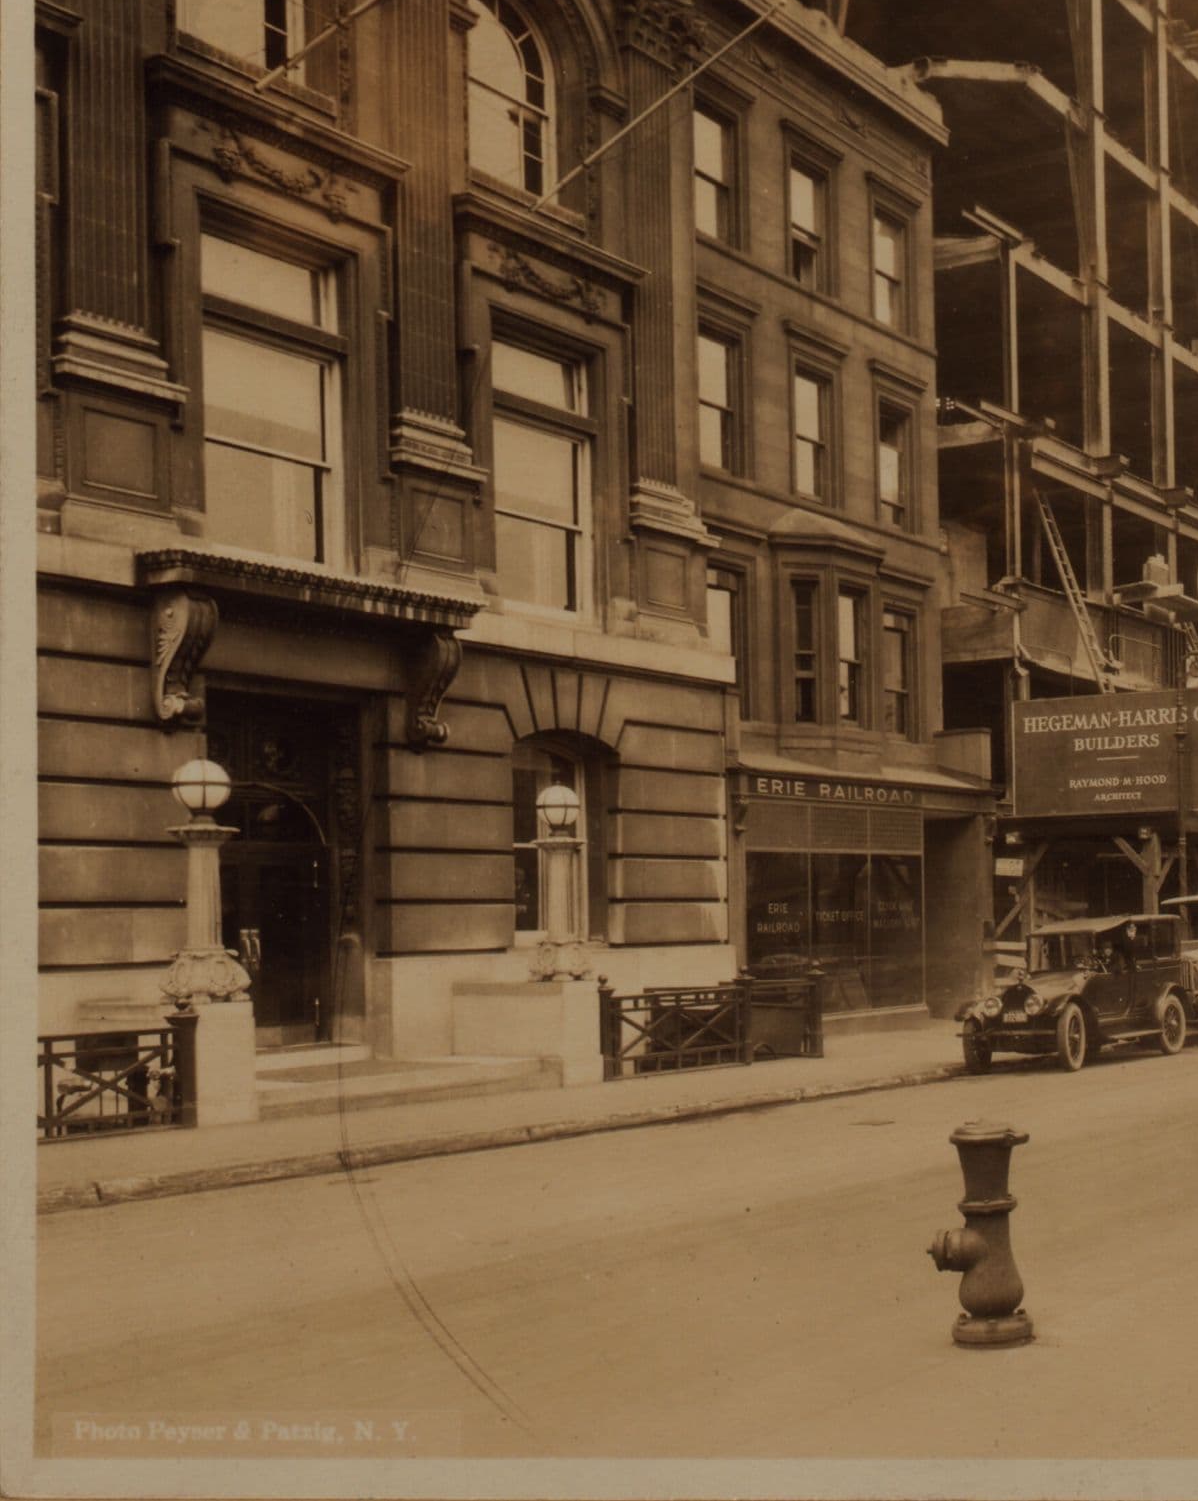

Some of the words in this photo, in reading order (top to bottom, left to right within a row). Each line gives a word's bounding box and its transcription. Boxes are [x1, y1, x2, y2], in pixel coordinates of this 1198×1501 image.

[1074, 733, 1160, 751] BUILDERS
[1135, 774, 1167, 786] HOOD
[756, 777, 806, 797] ERIE
[819, 783, 913, 804] RAILROAD
[1094, 791, 1142, 802] ARCHITECT
[768, 902, 789, 915] ERIE
[756, 921, 801, 934] RAILROAD
